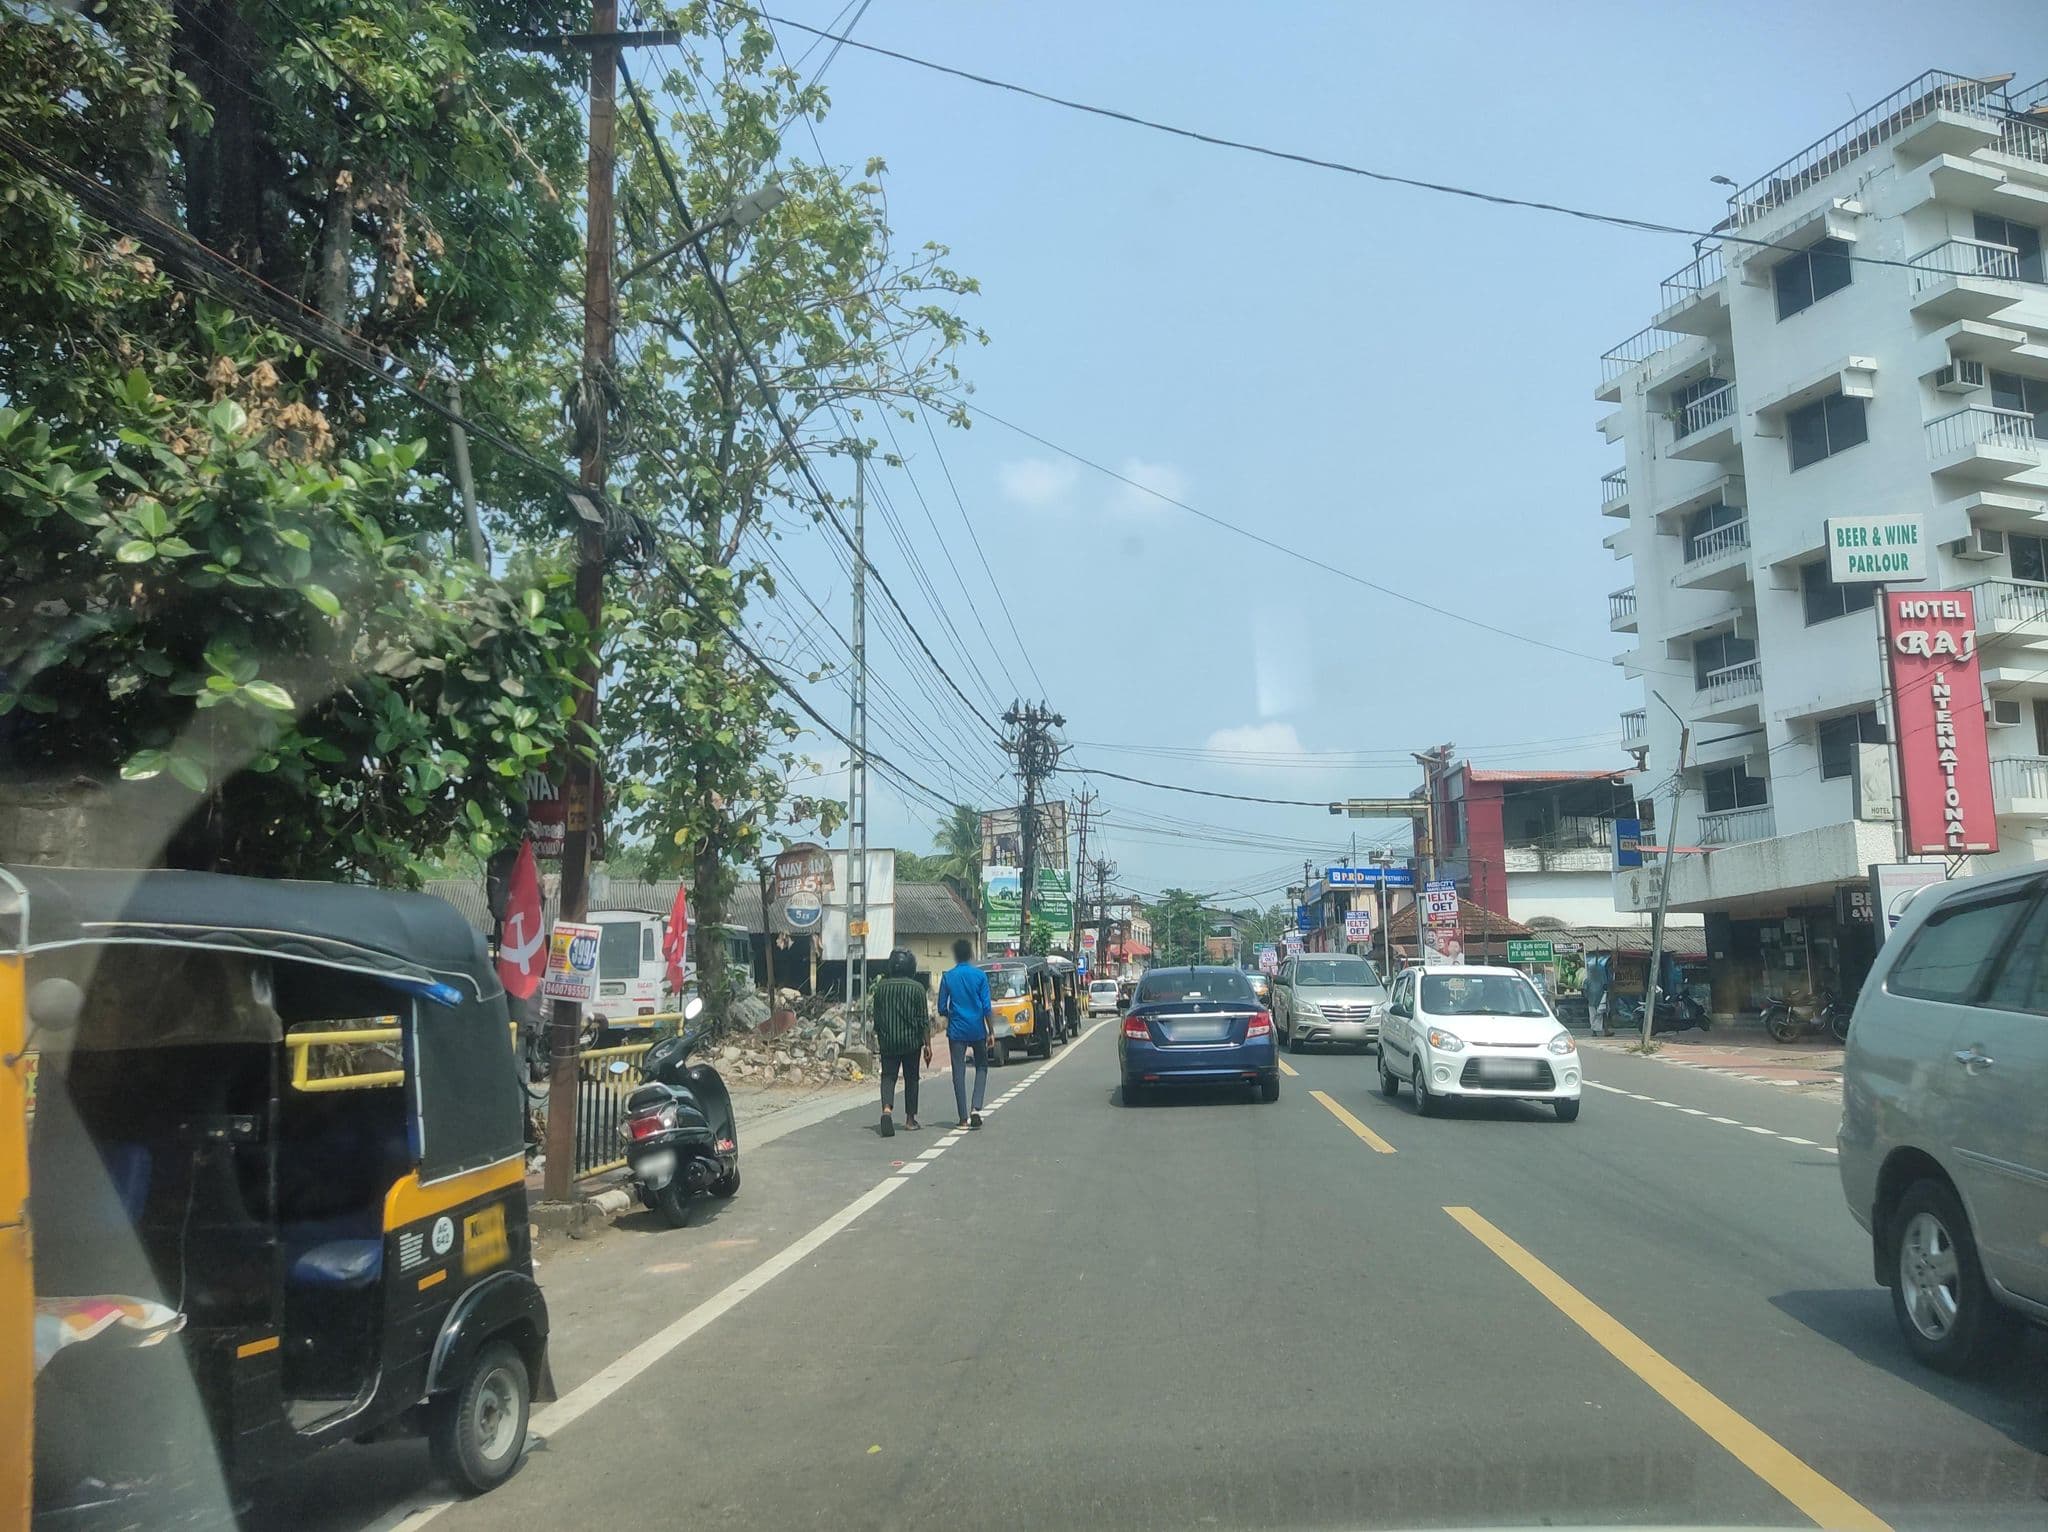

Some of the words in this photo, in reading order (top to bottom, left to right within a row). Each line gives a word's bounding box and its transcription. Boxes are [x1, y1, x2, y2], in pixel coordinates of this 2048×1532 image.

[1836, 526, 1868, 548] BEER
[1872, 526, 1882, 545] &
[1885, 524, 1918, 546] WINE
[1848, 551, 1910, 574] PARLOUR
[1900, 600, 1967, 620] HOTEL
[1896, 629, 1977, 662] RAJ
[1931, 671, 1965, 849] INTERNATIONAL
[1871, 807, 1891, 815] HOTEL
[778, 862, 803, 878] WAY
[1427, 892, 1456, 902] IELTS
[1432, 902, 1453, 912] OET
[1346, 920, 1368, 928] IELTS
[1349, 927, 1366, 935] OET
